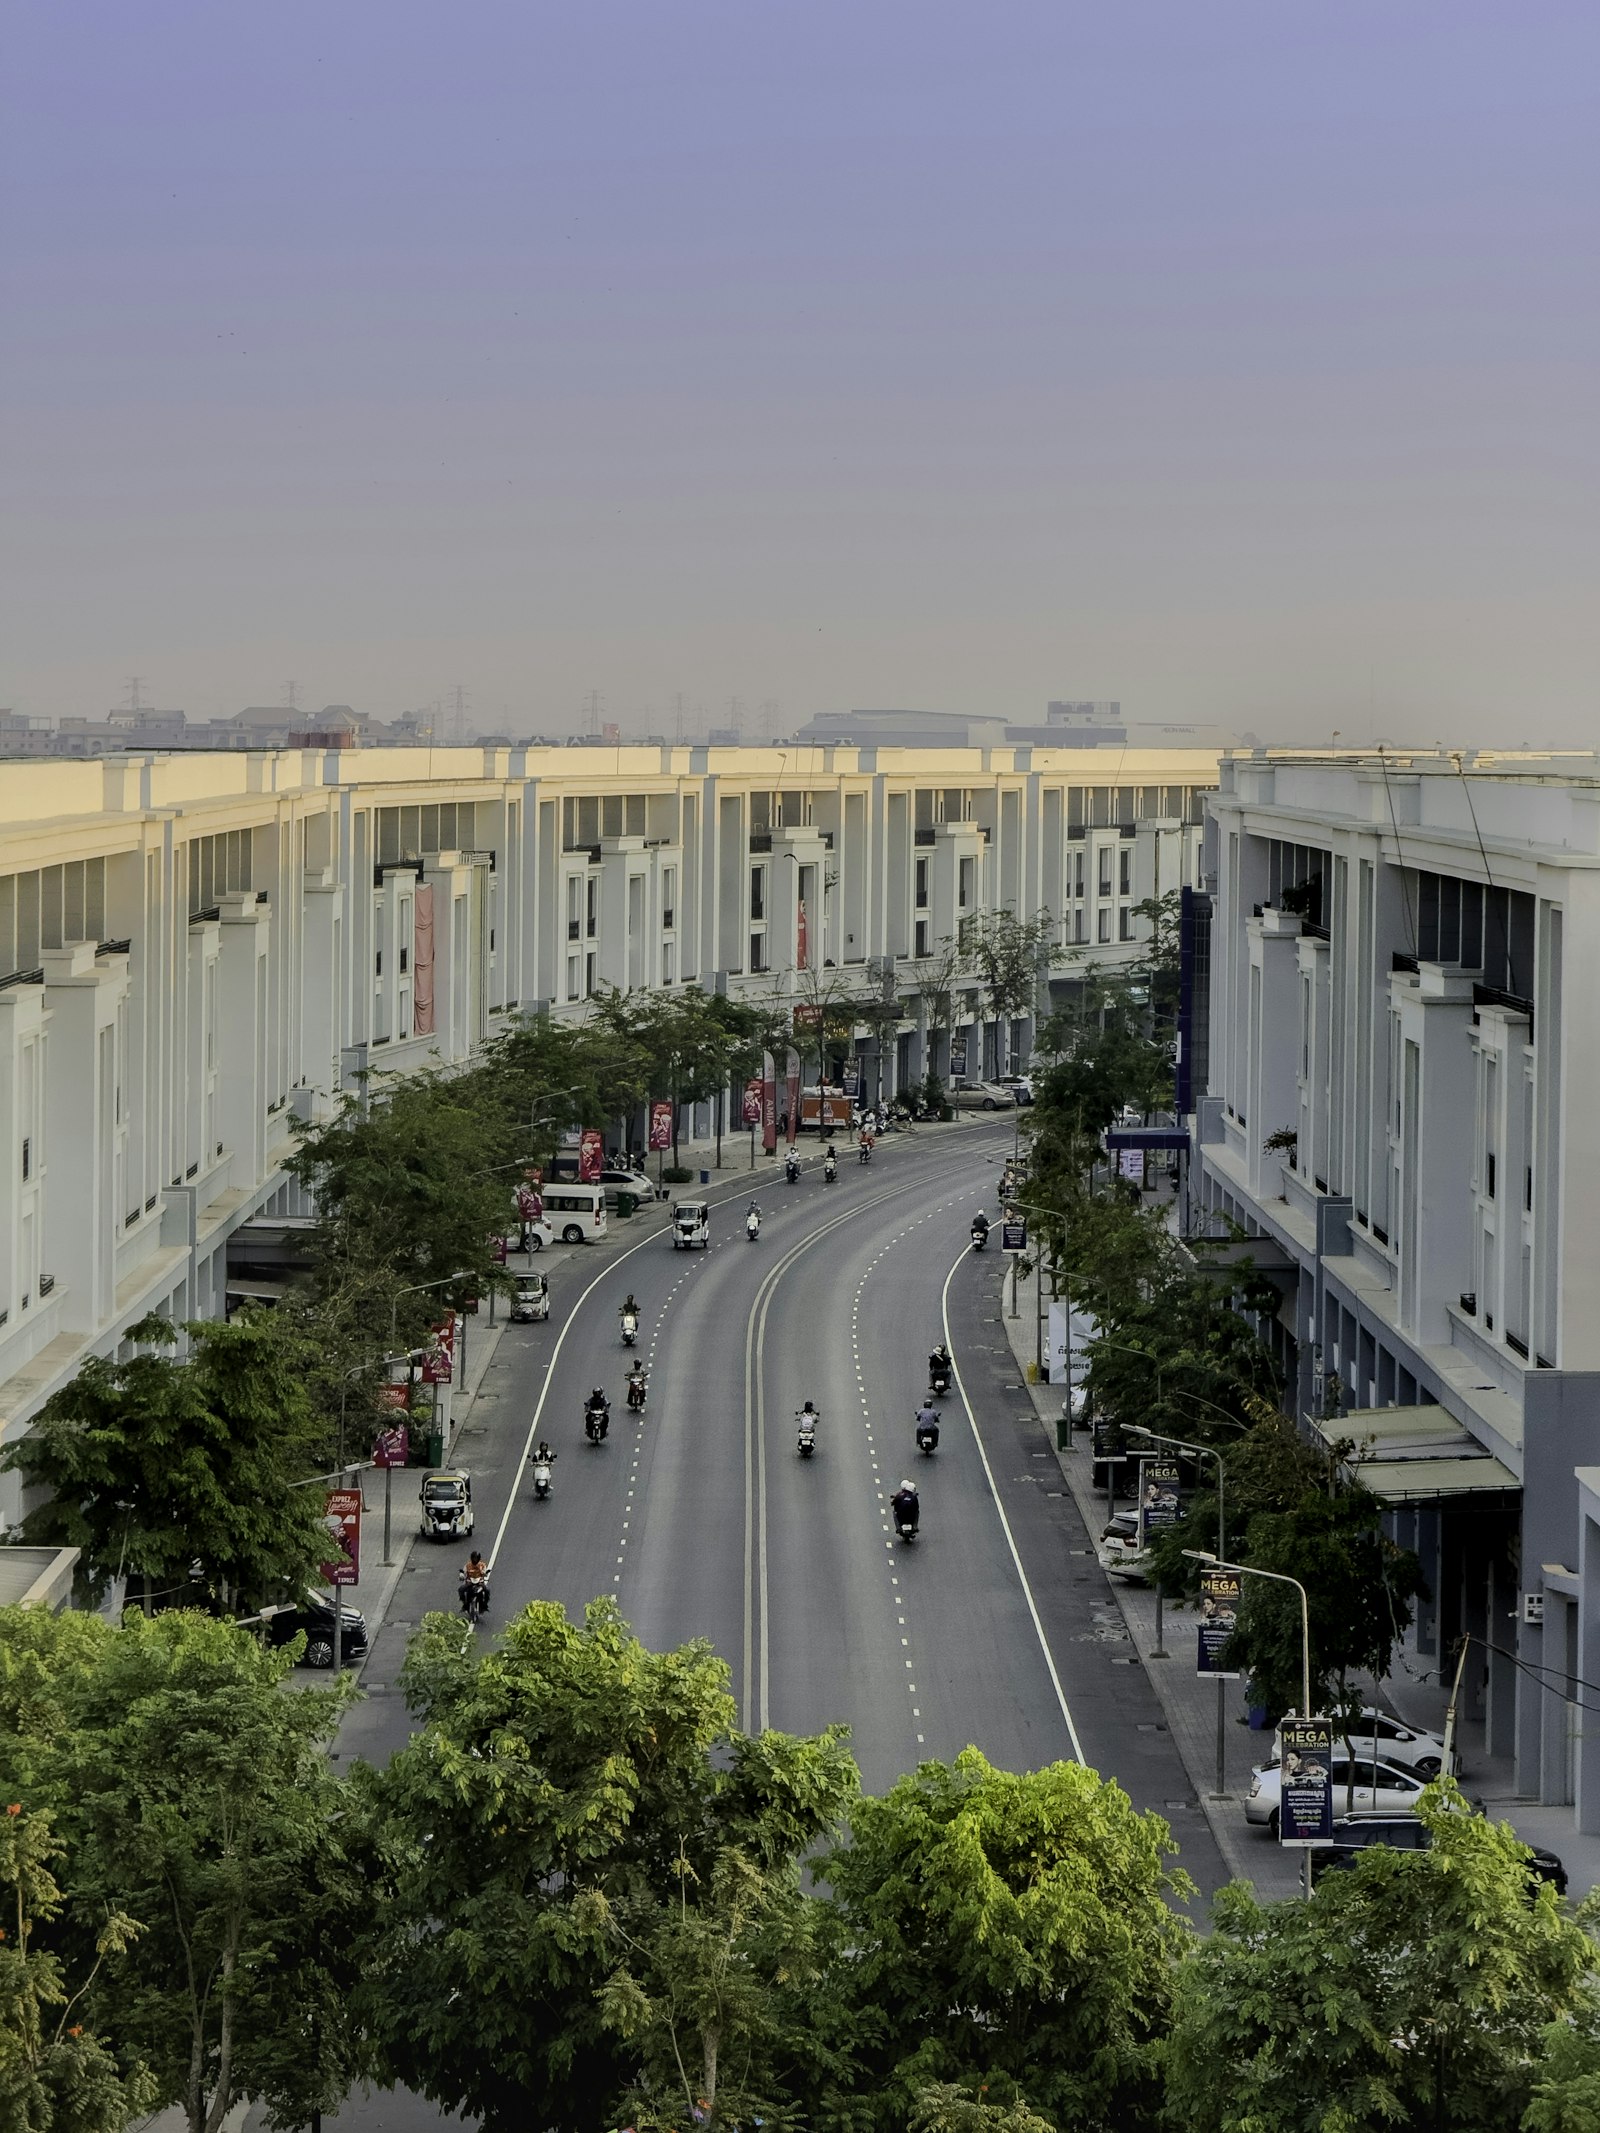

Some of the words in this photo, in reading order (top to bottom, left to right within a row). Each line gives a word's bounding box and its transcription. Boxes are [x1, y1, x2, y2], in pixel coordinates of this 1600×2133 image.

[766, 1098, 775, 1126] AMIA
[1145, 1468, 1178, 1477] MEGA
[1201, 1581, 1238, 1590] MEGA
[1283, 1731, 1328, 1743] MEGA
